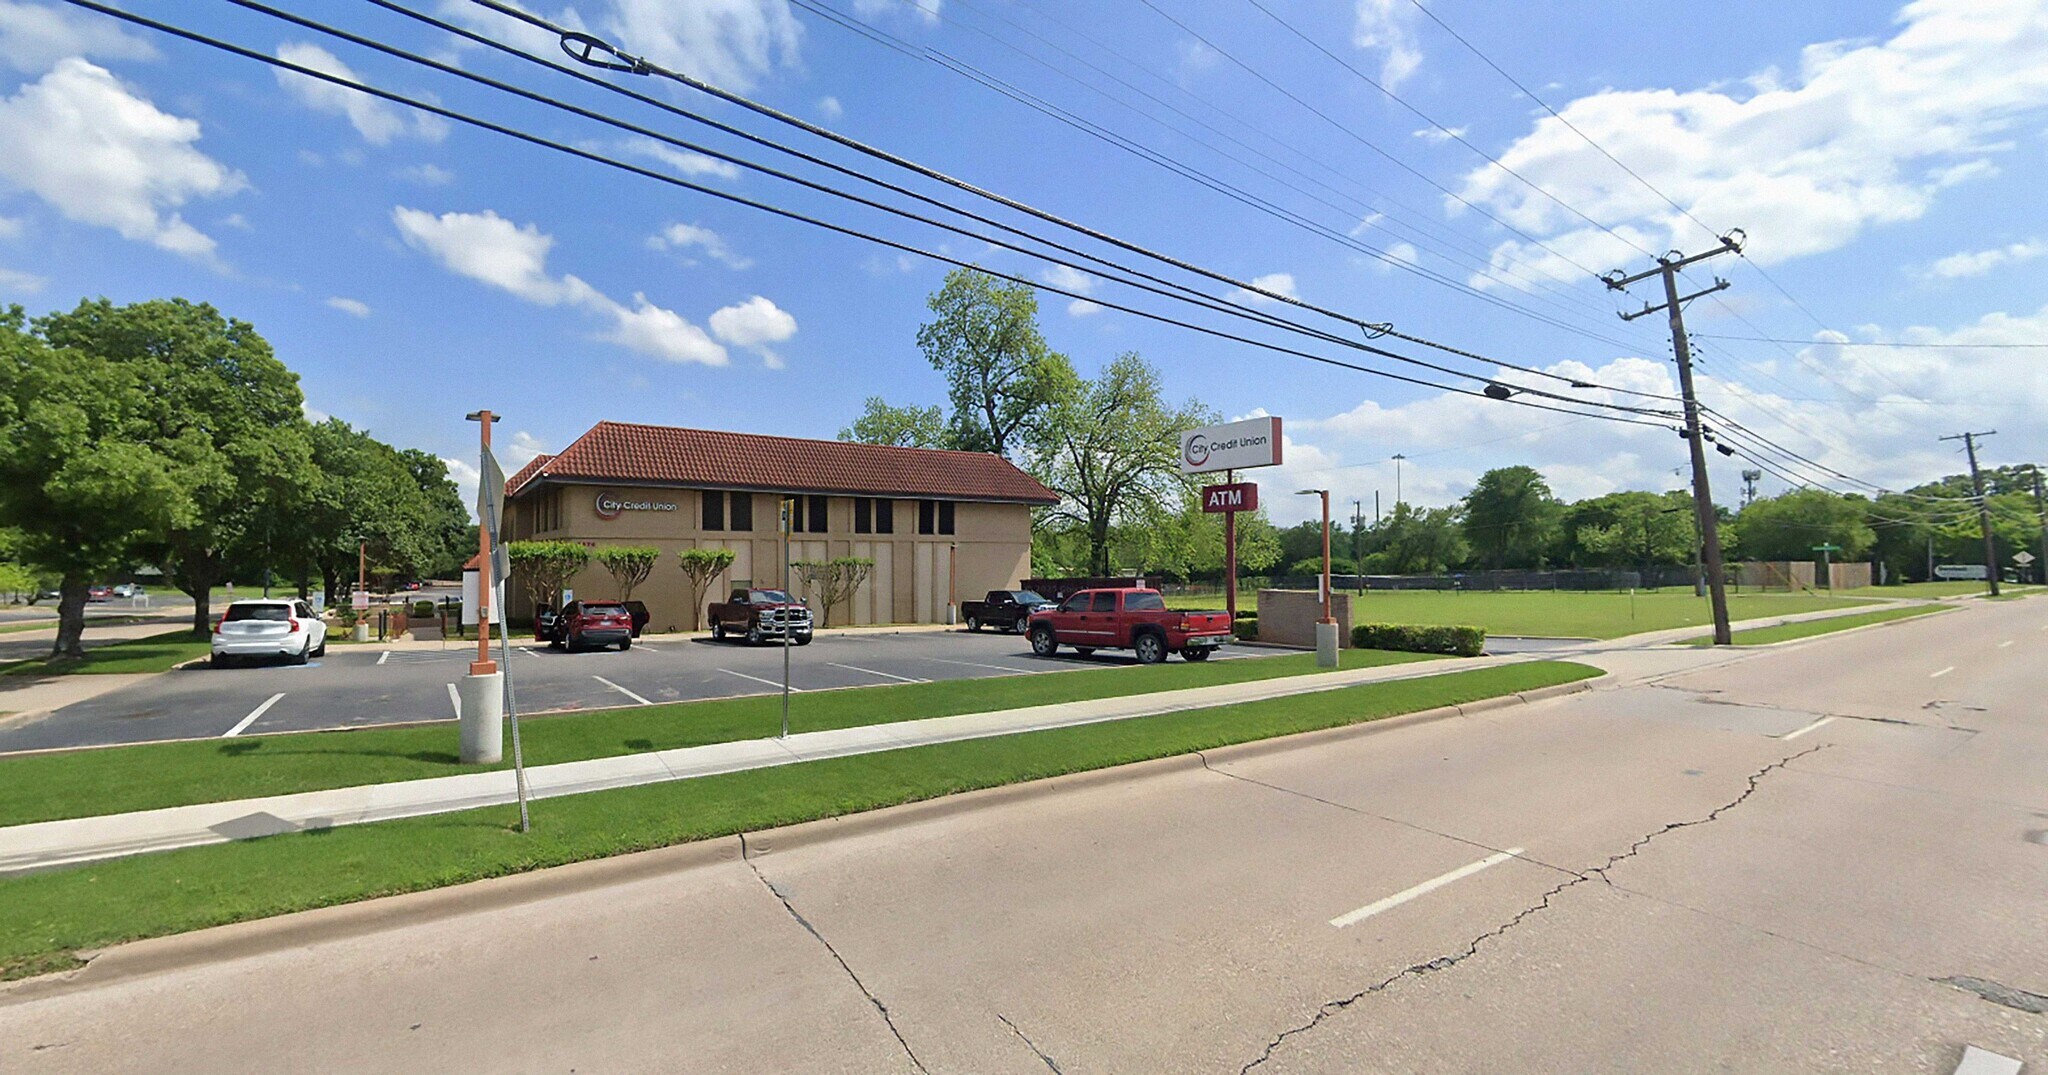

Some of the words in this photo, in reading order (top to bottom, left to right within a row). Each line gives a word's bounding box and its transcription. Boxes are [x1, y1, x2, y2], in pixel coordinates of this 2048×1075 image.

[1192, 444, 1209, 454] City
[1211, 440, 1238, 452] Credit
[1240, 436, 1266, 447] Union
[603, 500, 621, 510] City
[623, 501, 651, 510] Credit
[652, 503, 677, 511] Union
[1208, 489, 1242, 506] ATM
